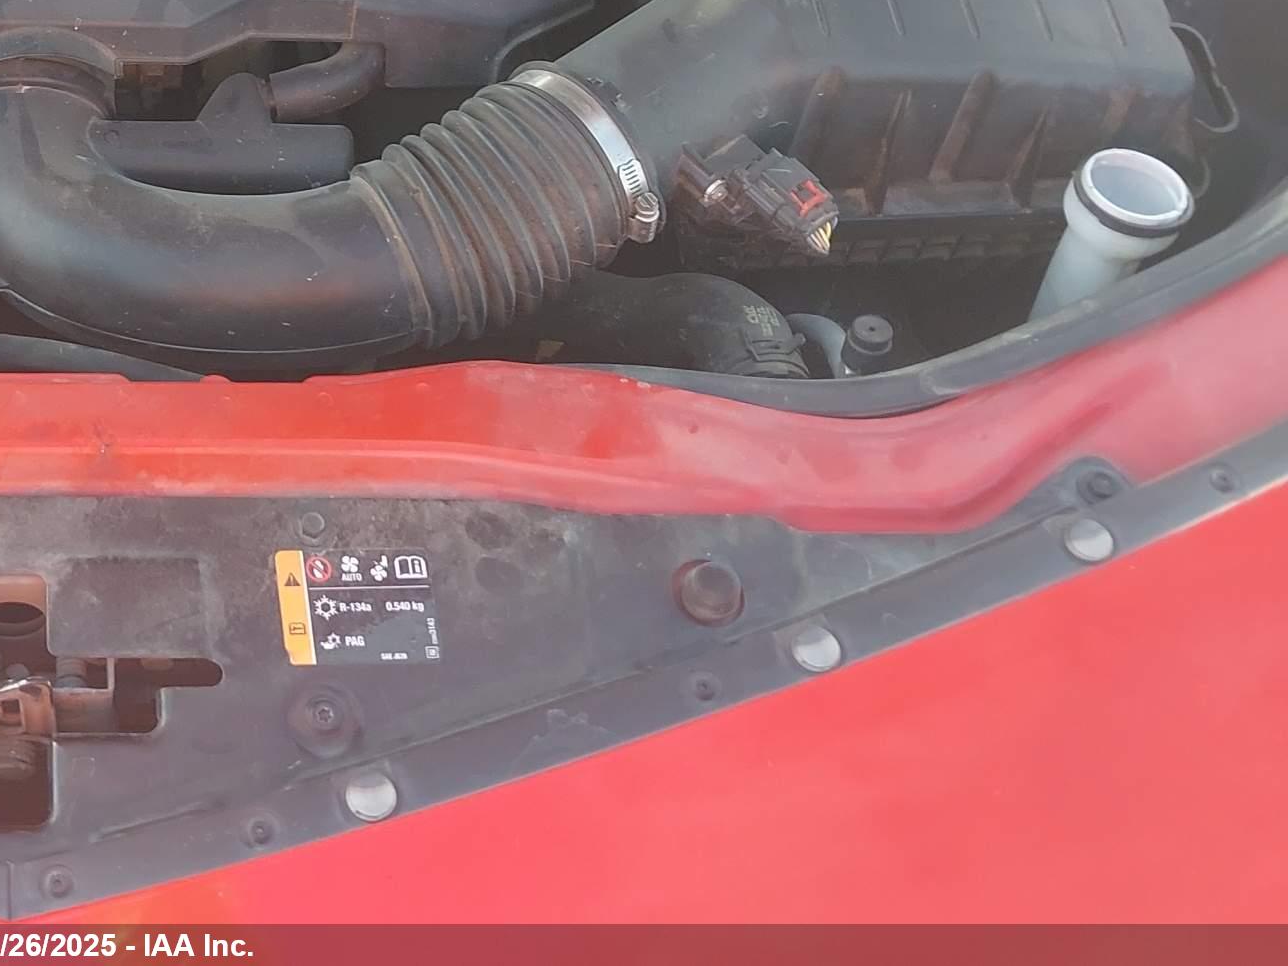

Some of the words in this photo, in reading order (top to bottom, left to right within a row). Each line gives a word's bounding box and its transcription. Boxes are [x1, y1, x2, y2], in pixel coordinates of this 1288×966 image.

[341, 573, 362, 582] AUTO
[339, 602, 372, 612] R-134a
[385, 601, 410, 612] 0.540
[412, 601, 425, 613] kg
[345, 635, 365, 647] PAG
